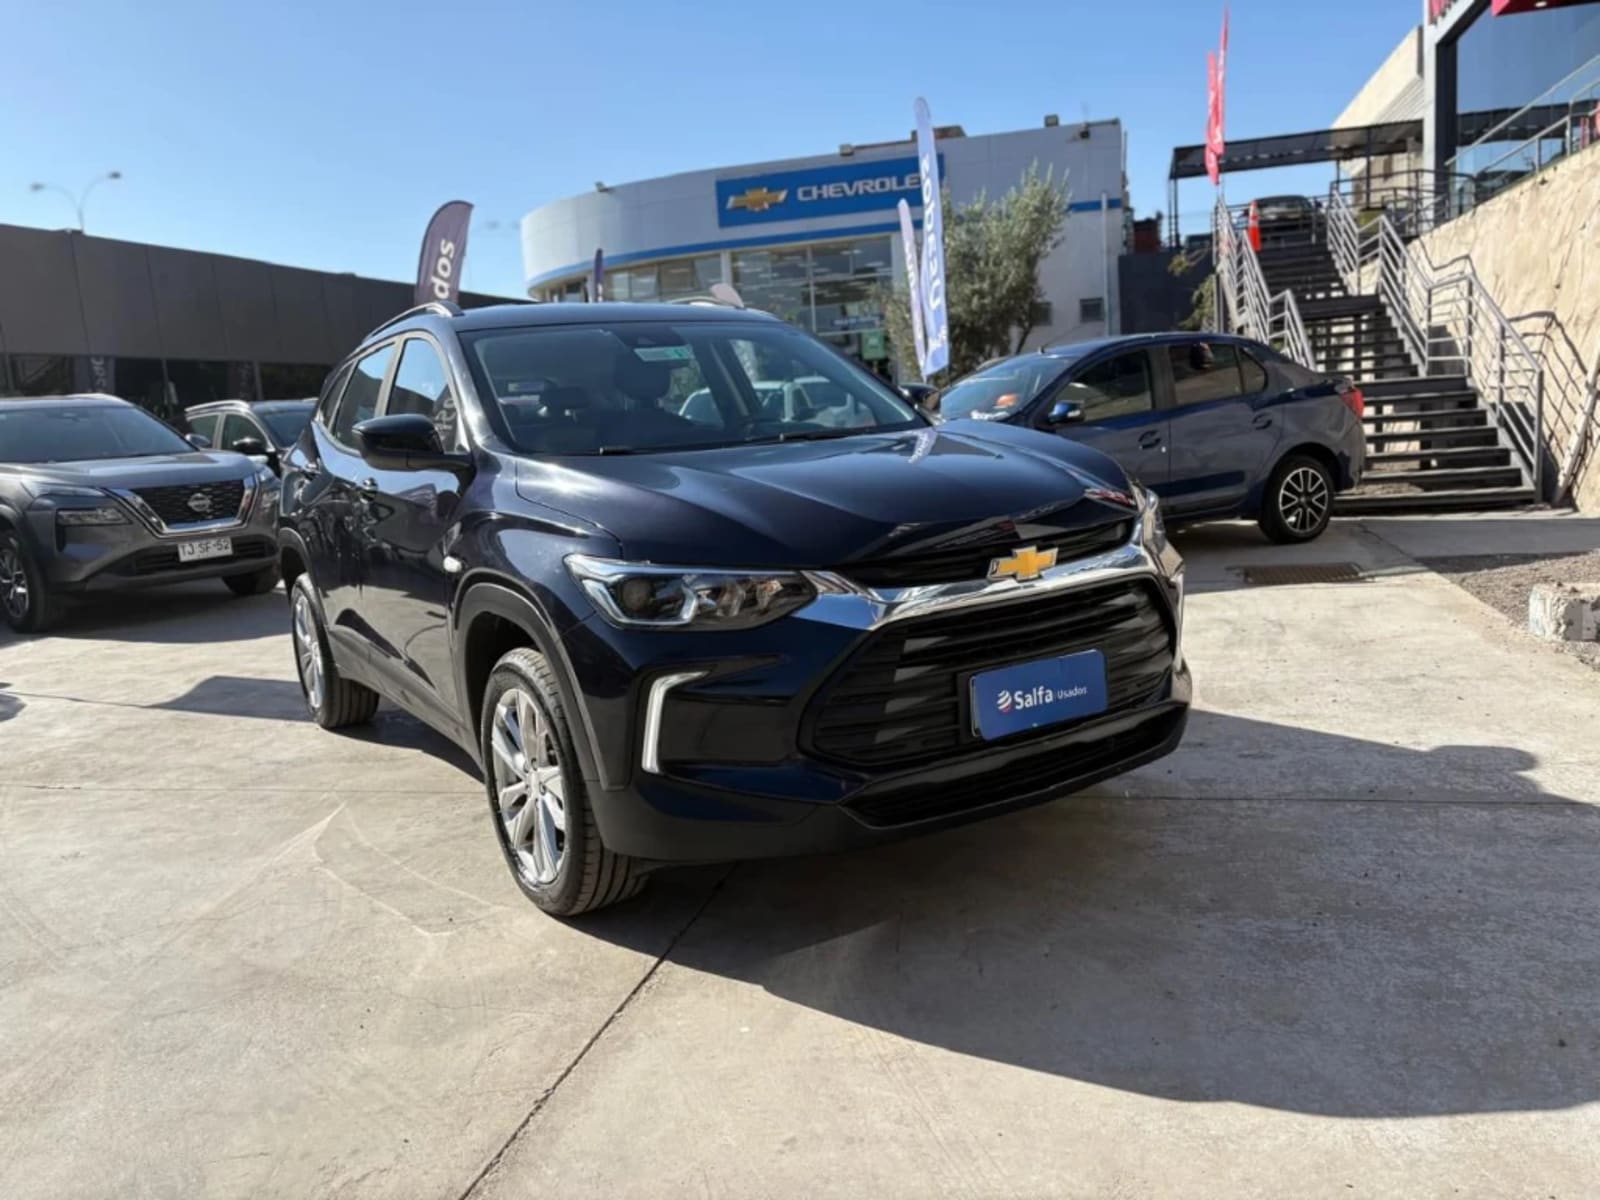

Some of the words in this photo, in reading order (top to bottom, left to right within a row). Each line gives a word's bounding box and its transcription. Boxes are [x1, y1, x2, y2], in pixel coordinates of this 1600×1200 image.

[798, 174, 920, 201] CHEVROLE
[431, 239, 455, 299] dos
[1014, 686, 1054, 710] Salfa
[1057, 686, 1087, 700] Usados
